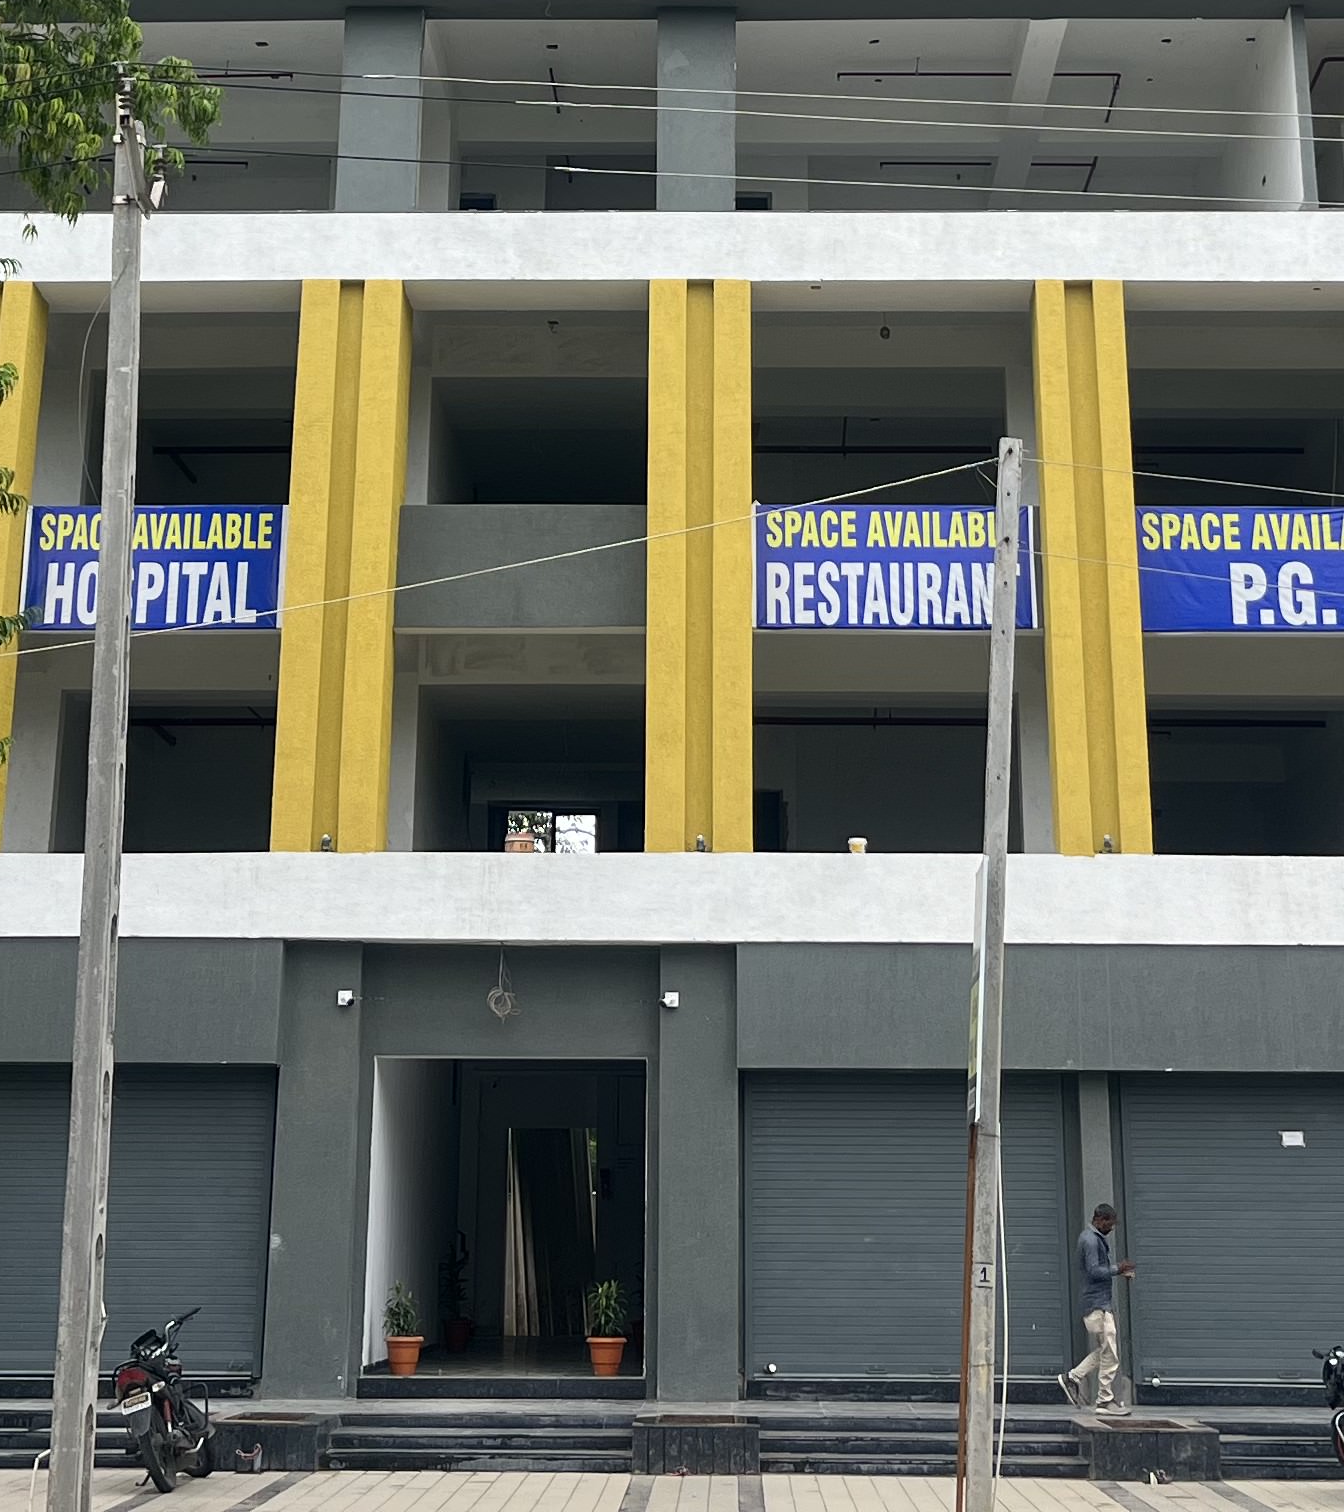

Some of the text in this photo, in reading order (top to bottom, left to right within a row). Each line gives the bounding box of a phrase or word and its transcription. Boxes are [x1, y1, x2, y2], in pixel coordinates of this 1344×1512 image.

[40, 513, 273, 551] SPAC AVAILABLE
[766, 509, 997, 548] SPACE AVAILABL
[1142, 512, 1241, 552] SPACE
[44, 561, 257, 626] HOPITAL
[766, 561, 1020, 626] RESTAURAN
[1229, 562, 1338, 626] P.G.
[980, 1267, 991, 1282] 1
